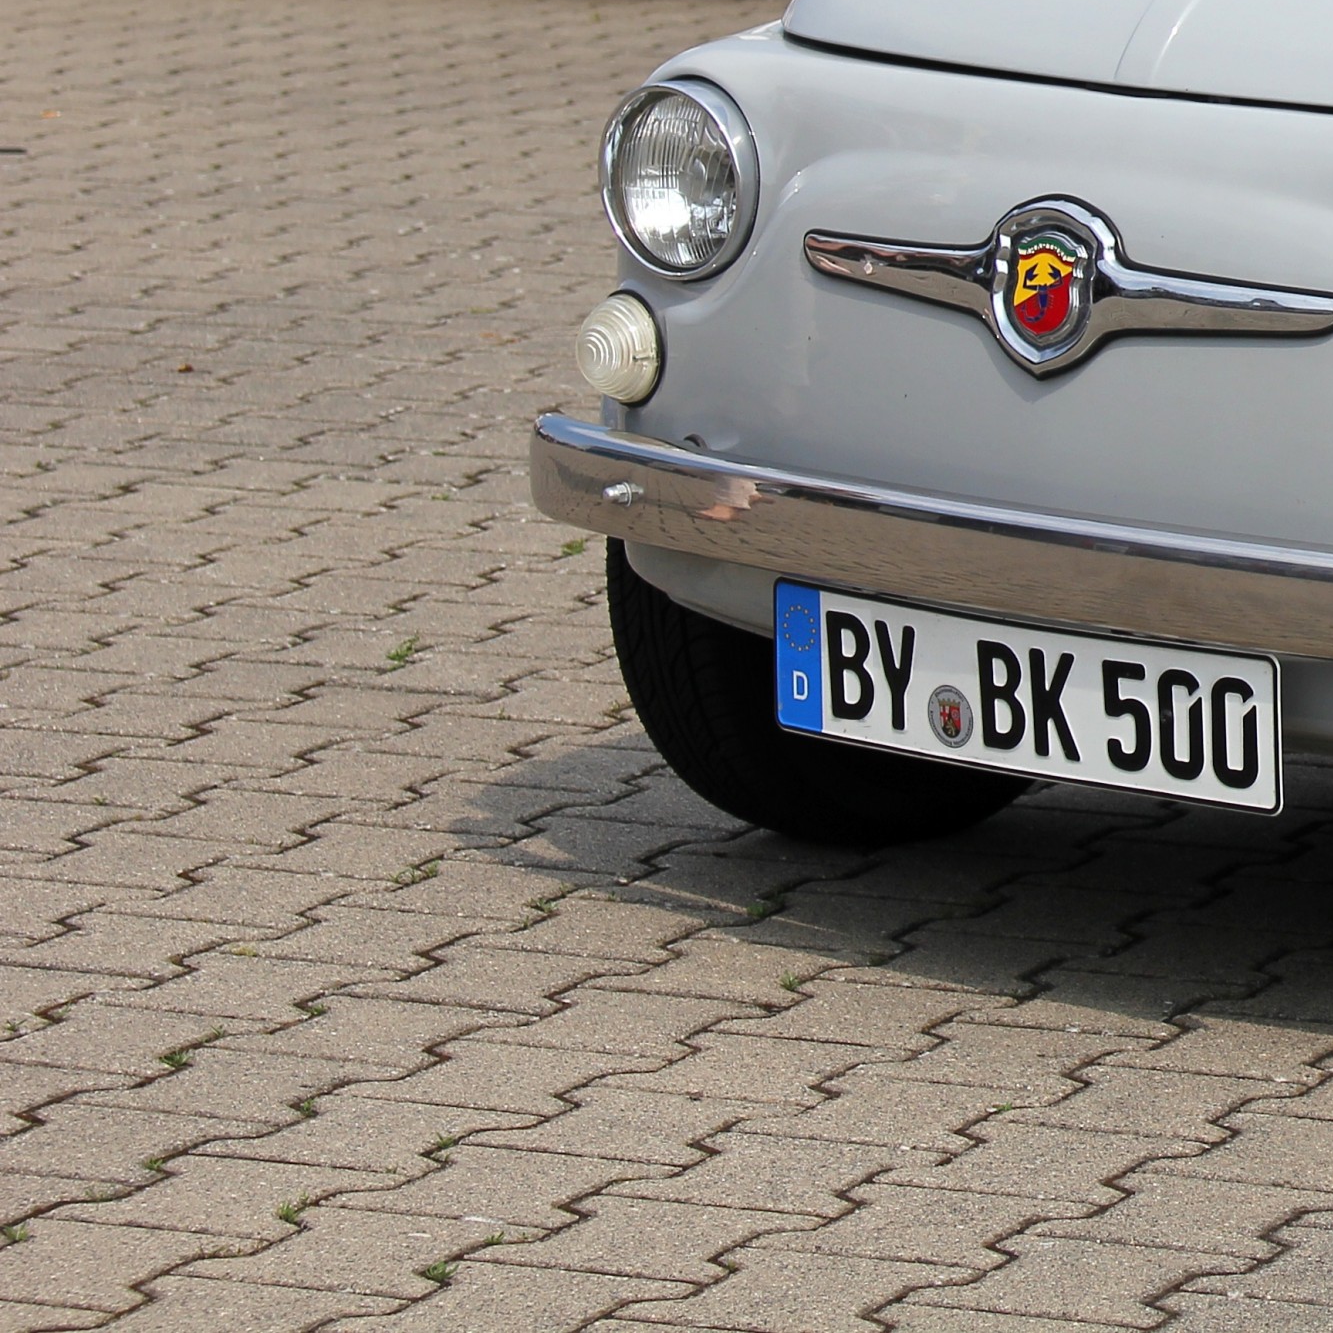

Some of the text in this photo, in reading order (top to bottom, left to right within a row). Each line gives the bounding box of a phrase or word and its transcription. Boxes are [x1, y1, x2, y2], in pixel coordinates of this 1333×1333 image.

[792, 669, 809, 701] D
[825, 610, 1258, 789] BY BK 500
